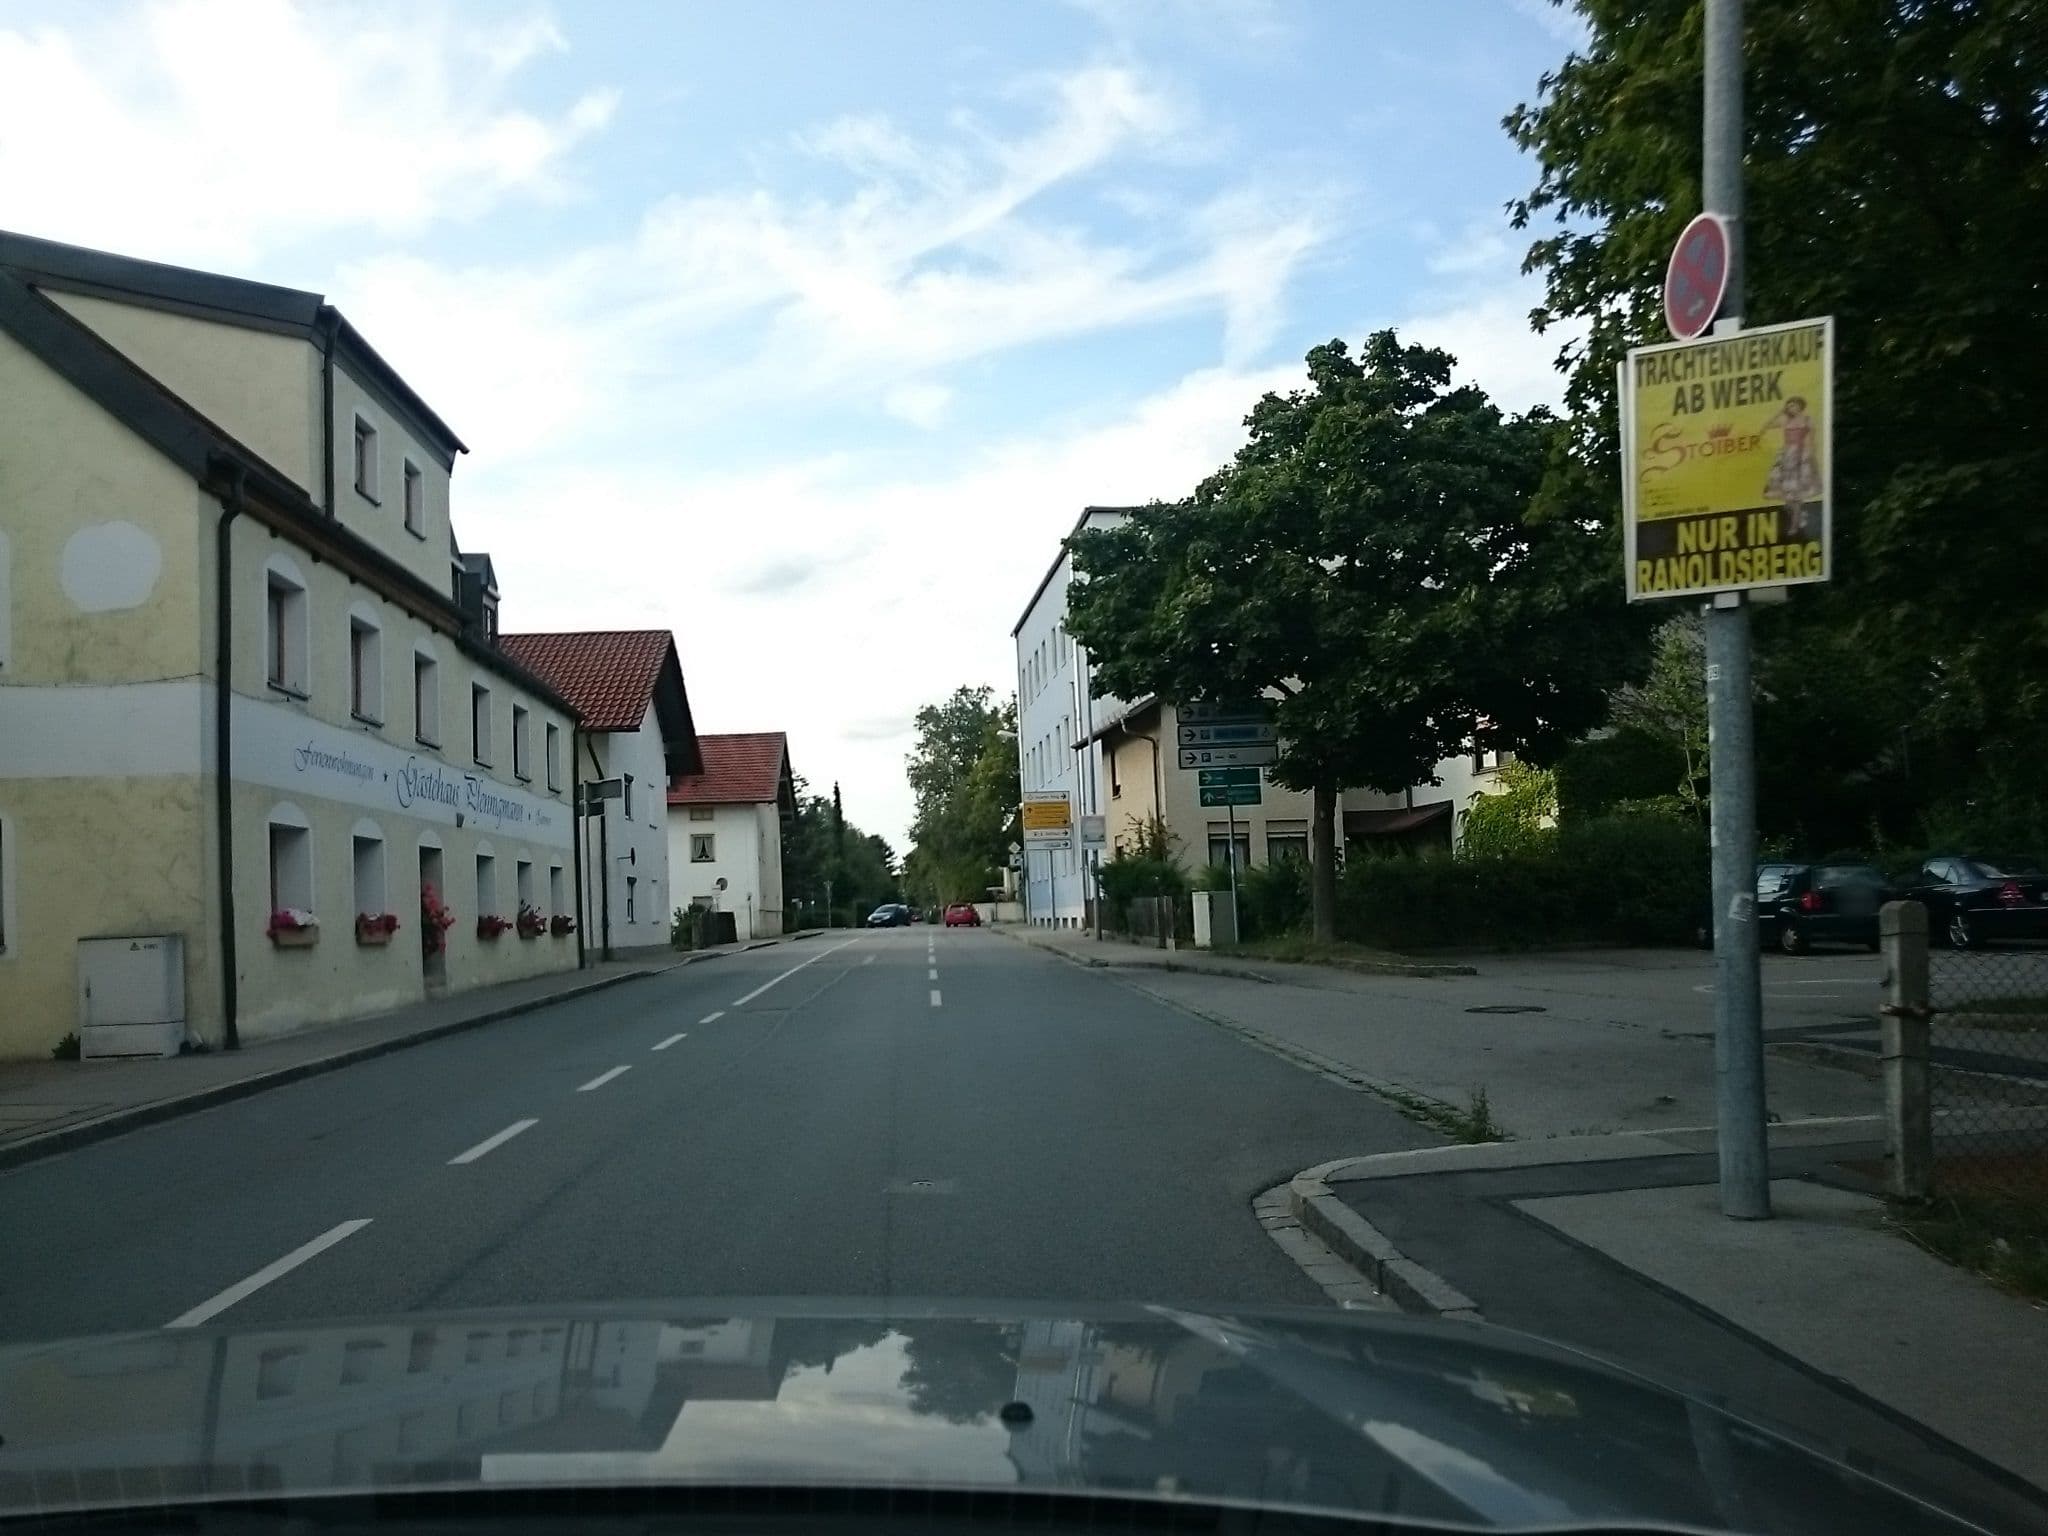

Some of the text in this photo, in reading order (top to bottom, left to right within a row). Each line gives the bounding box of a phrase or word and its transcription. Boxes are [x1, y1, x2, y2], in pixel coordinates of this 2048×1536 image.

[1635, 327, 1824, 388] TRACHTENVERKAUF
[1673, 370, 1783, 416] AB WERK
[1677, 511, 1778, 554] NUR IN
[1636, 541, 1823, 593] RANOLDSBERG
